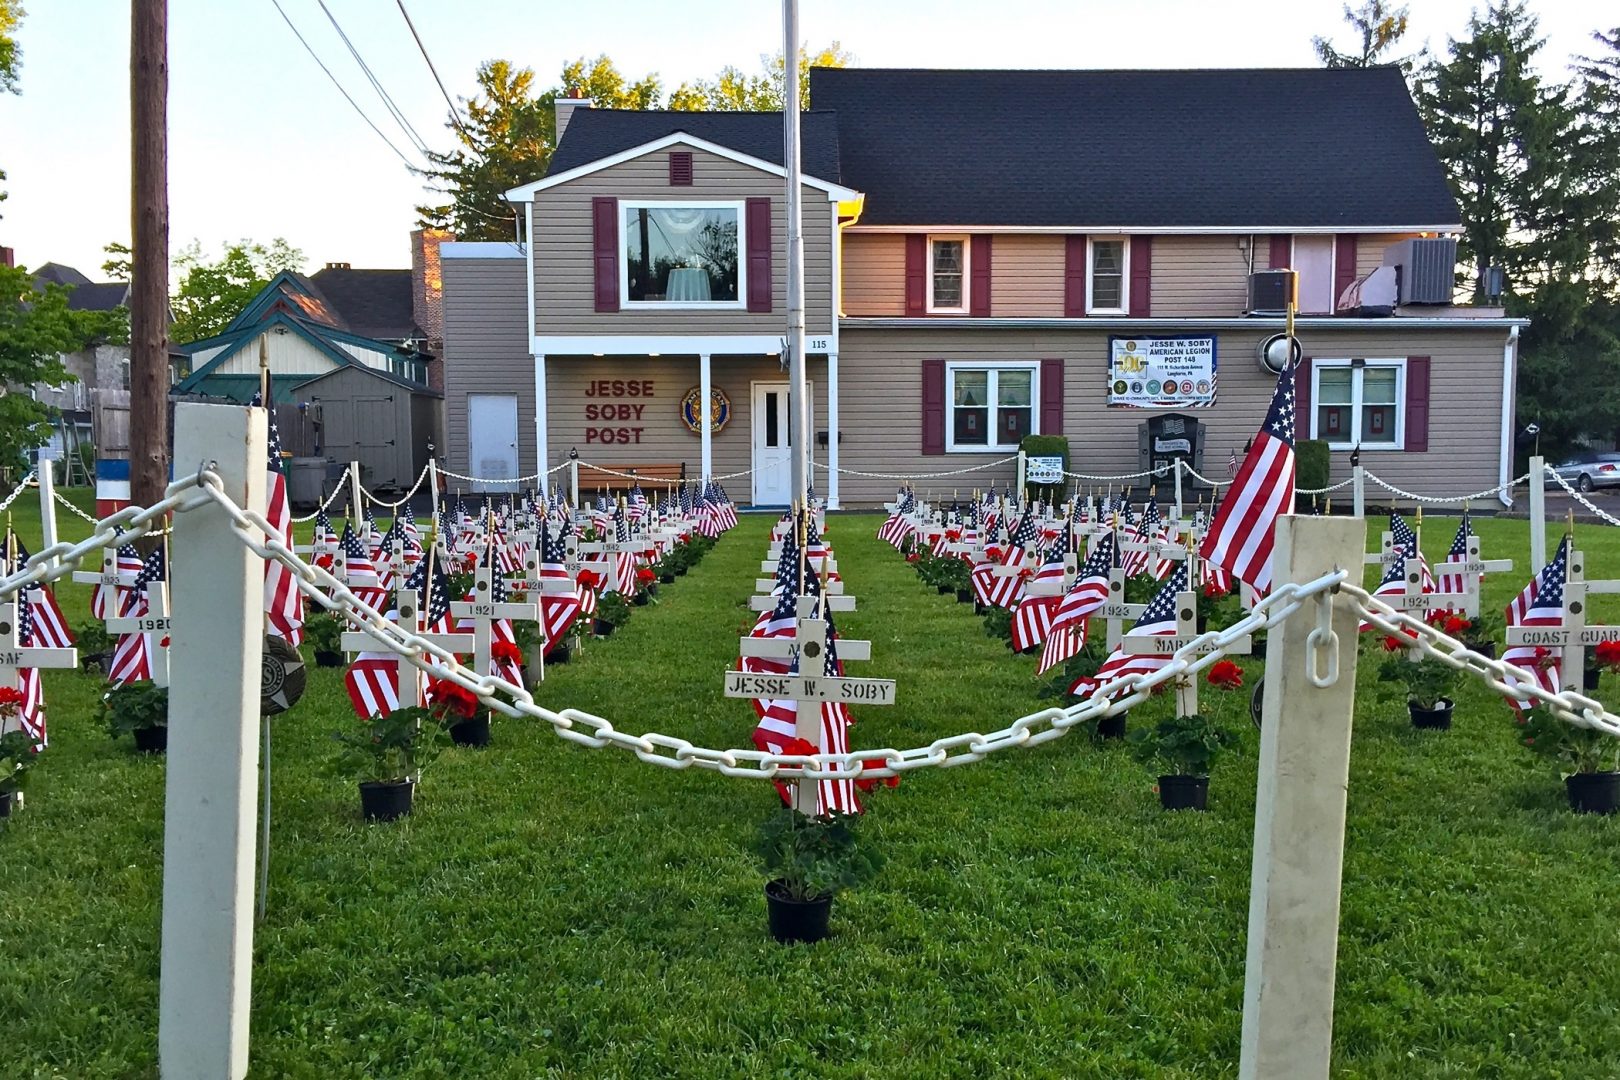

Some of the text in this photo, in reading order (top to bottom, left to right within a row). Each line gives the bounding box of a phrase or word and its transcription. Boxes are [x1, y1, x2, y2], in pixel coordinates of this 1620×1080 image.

[812, 340, 826, 348] 115
[1149, 340, 1175, 348] JESSE
[1149, 348, 1184, 356] AMERICAN
[1185, 347, 1210, 355] LEGION
[585, 380, 654, 397] JESSE
[585, 404, 646, 420] SOBY
[585, 427, 644, 444] POST
[602, 542, 620, 550] 1942
[564, 563, 581, 571] 935
[1403, 597, 1430, 607] 1924
[469, 605, 495, 616] 1921
[1102, 606, 1130, 616] 1923
[1522, 630, 1619, 644] COAST GUAR
[0, 652, 24, 665] SAF
[729, 677, 889, 700] JESSE W. SOBY
